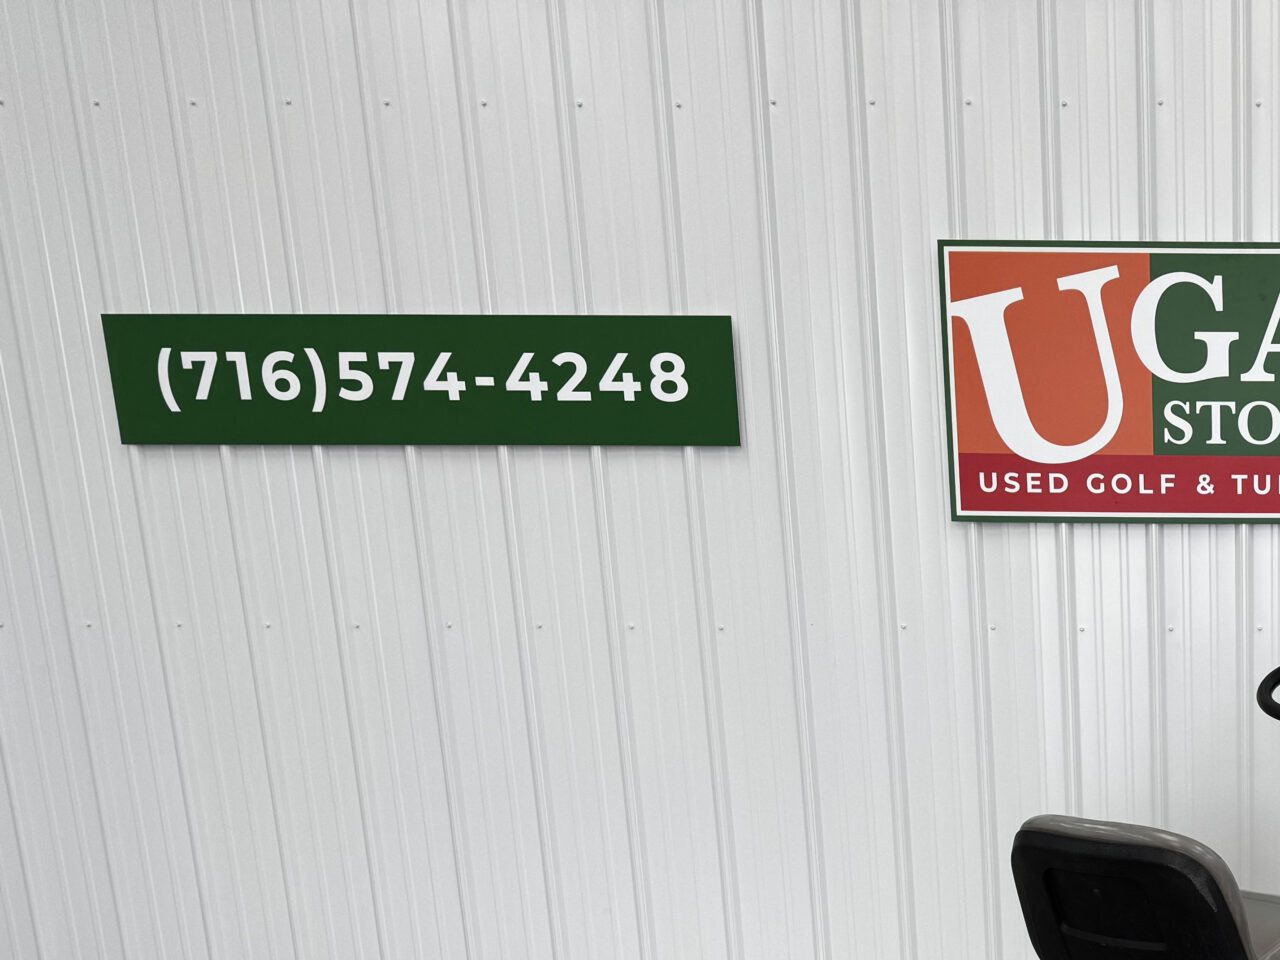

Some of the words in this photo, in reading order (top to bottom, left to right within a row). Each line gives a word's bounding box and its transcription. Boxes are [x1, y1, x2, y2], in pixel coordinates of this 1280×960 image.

[158, 348, 688, 412] (716)574-4248
[980, 472, 1068, 493] USED
[1087, 474, 1175, 494] GOLF
[1197, 474, 1214, 494] &
